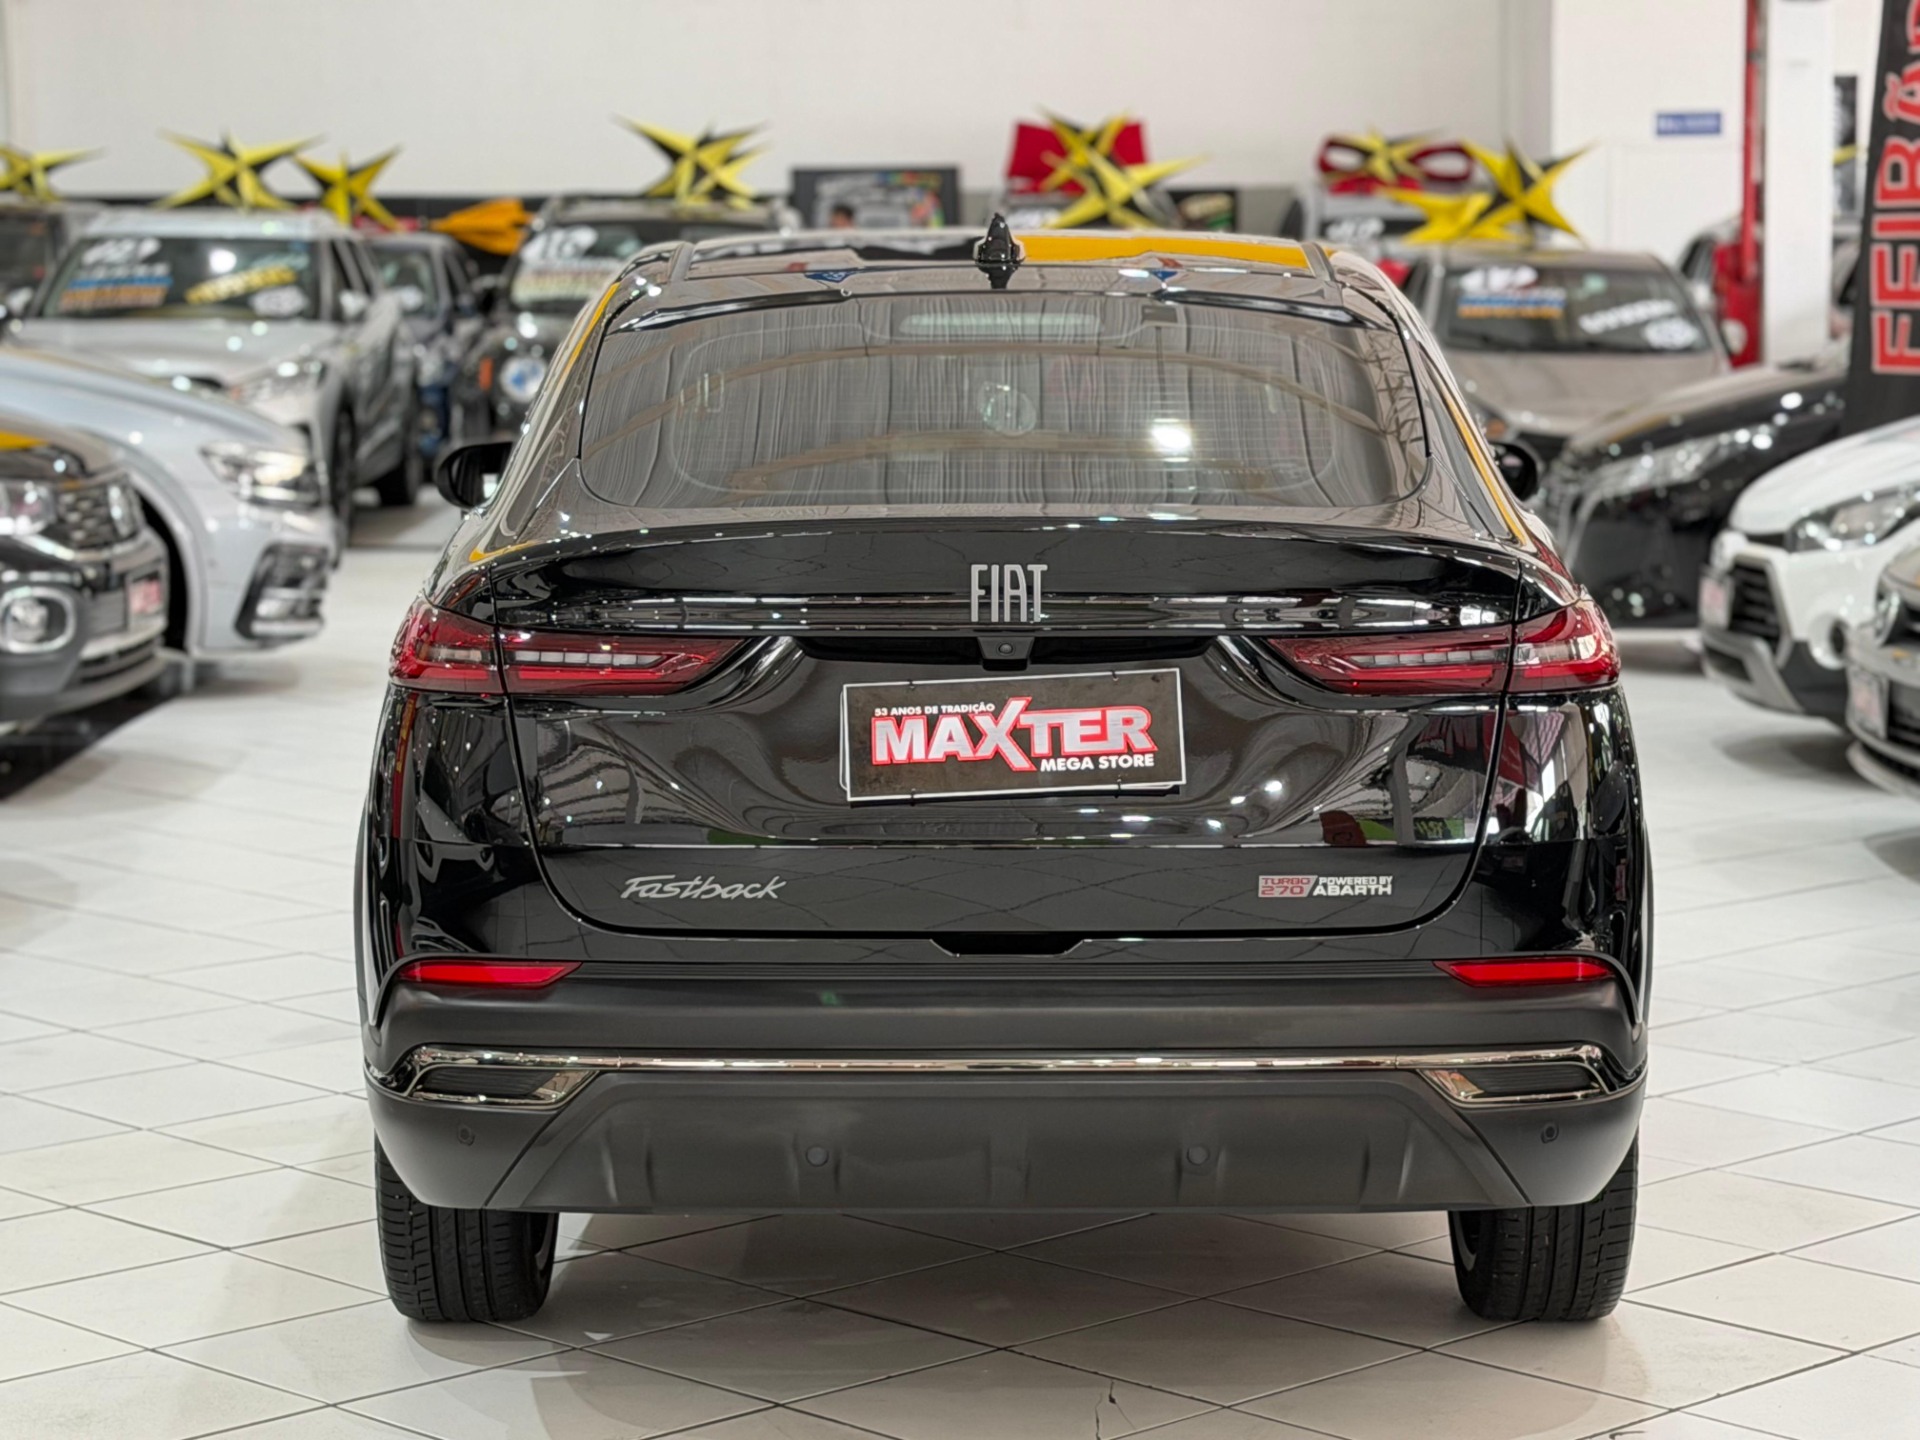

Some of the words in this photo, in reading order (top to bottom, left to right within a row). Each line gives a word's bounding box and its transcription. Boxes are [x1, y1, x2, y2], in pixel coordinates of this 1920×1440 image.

[971, 564, 1048, 622] FIAT
[875, 708, 888, 716] 53
[890, 706, 922, 716] ANOS
[924, 705, 938, 714] DE
[941, 702, 996, 714] TRADIÇÃO
[871, 696, 1158, 772] MAXTER
[1040, 756, 1095, 772] MEGA
[1099, 753, 1155, 769] STORE
[620, 874, 787, 899] Fastback
[1261, 877, 1311, 885] TURBO
[1318, 876, 1377, 885] POWERED
[1379, 876, 1393, 885] BY
[1261, 885, 1304, 896] 270
[1312, 885, 1393, 896] ABARTH
